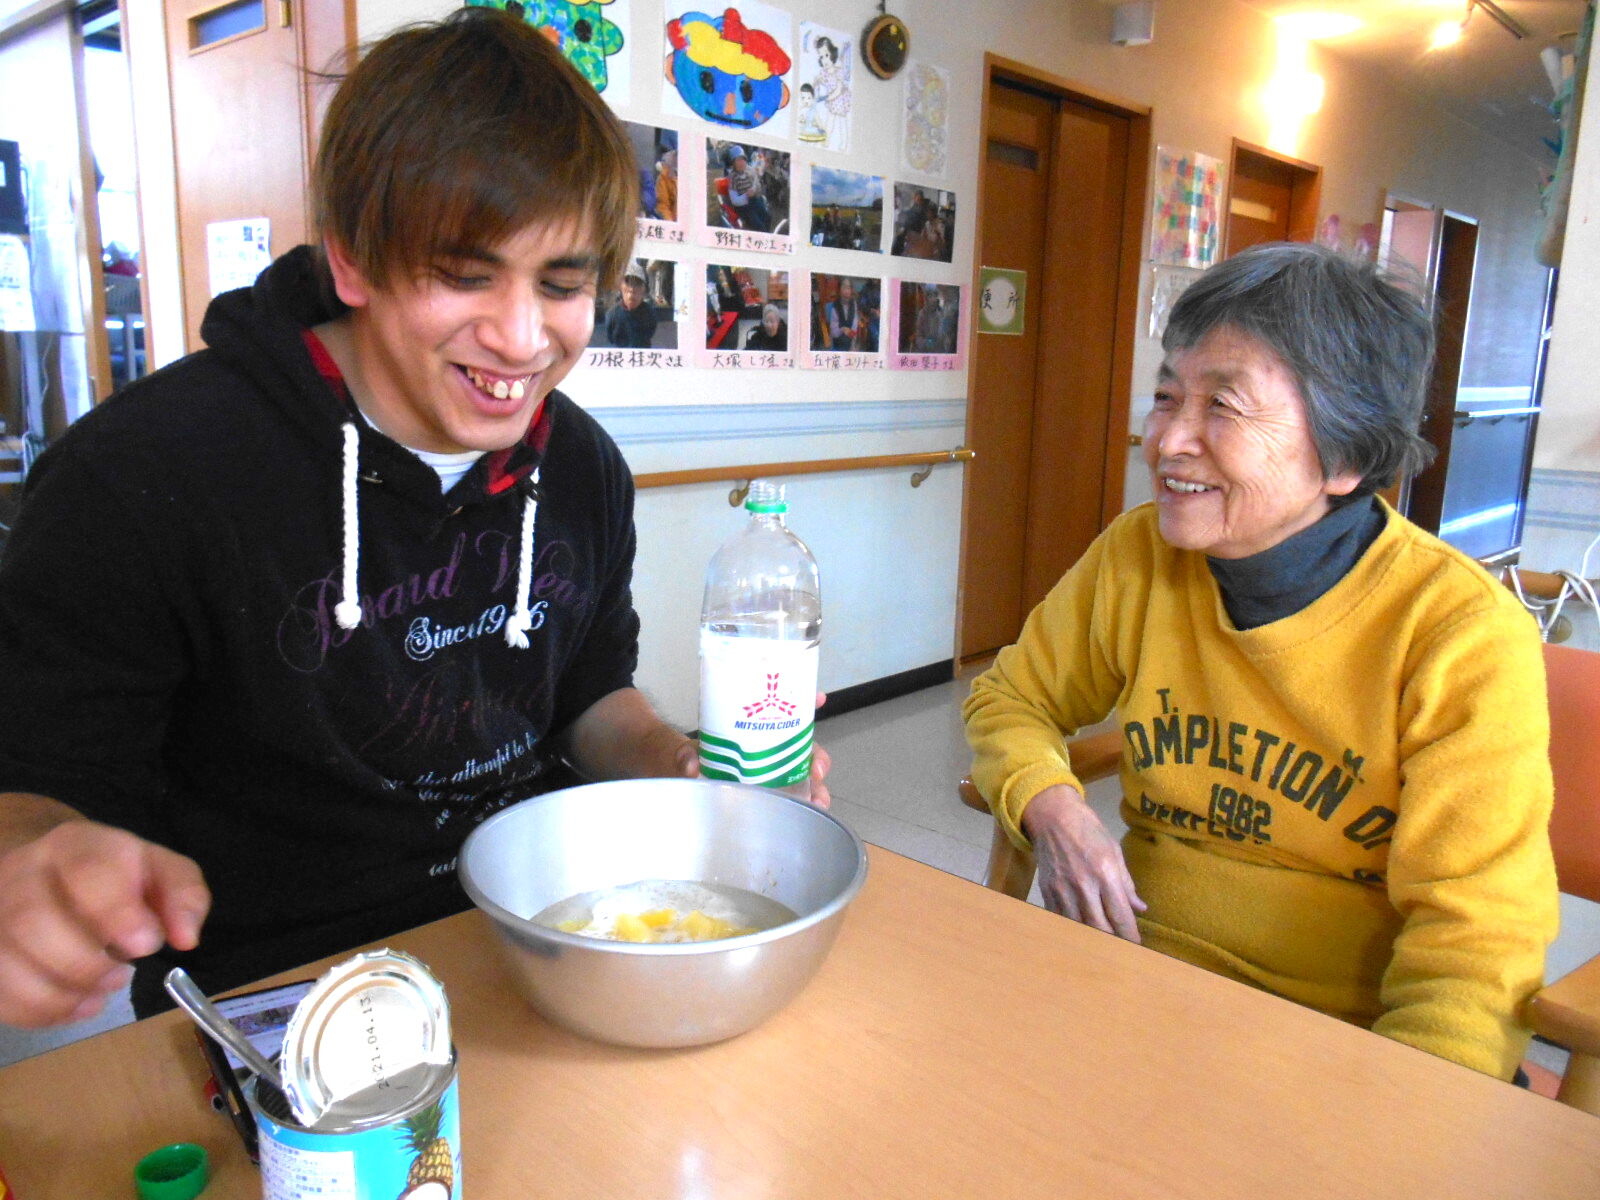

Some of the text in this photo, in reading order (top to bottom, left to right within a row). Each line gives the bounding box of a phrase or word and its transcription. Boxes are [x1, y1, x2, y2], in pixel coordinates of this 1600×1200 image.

[476, 600, 549, 634] 196
[734, 720, 776, 730] MITSUYA
[776, 717, 801, 730] CIDER
[1207, 783, 1272, 842] 1982
